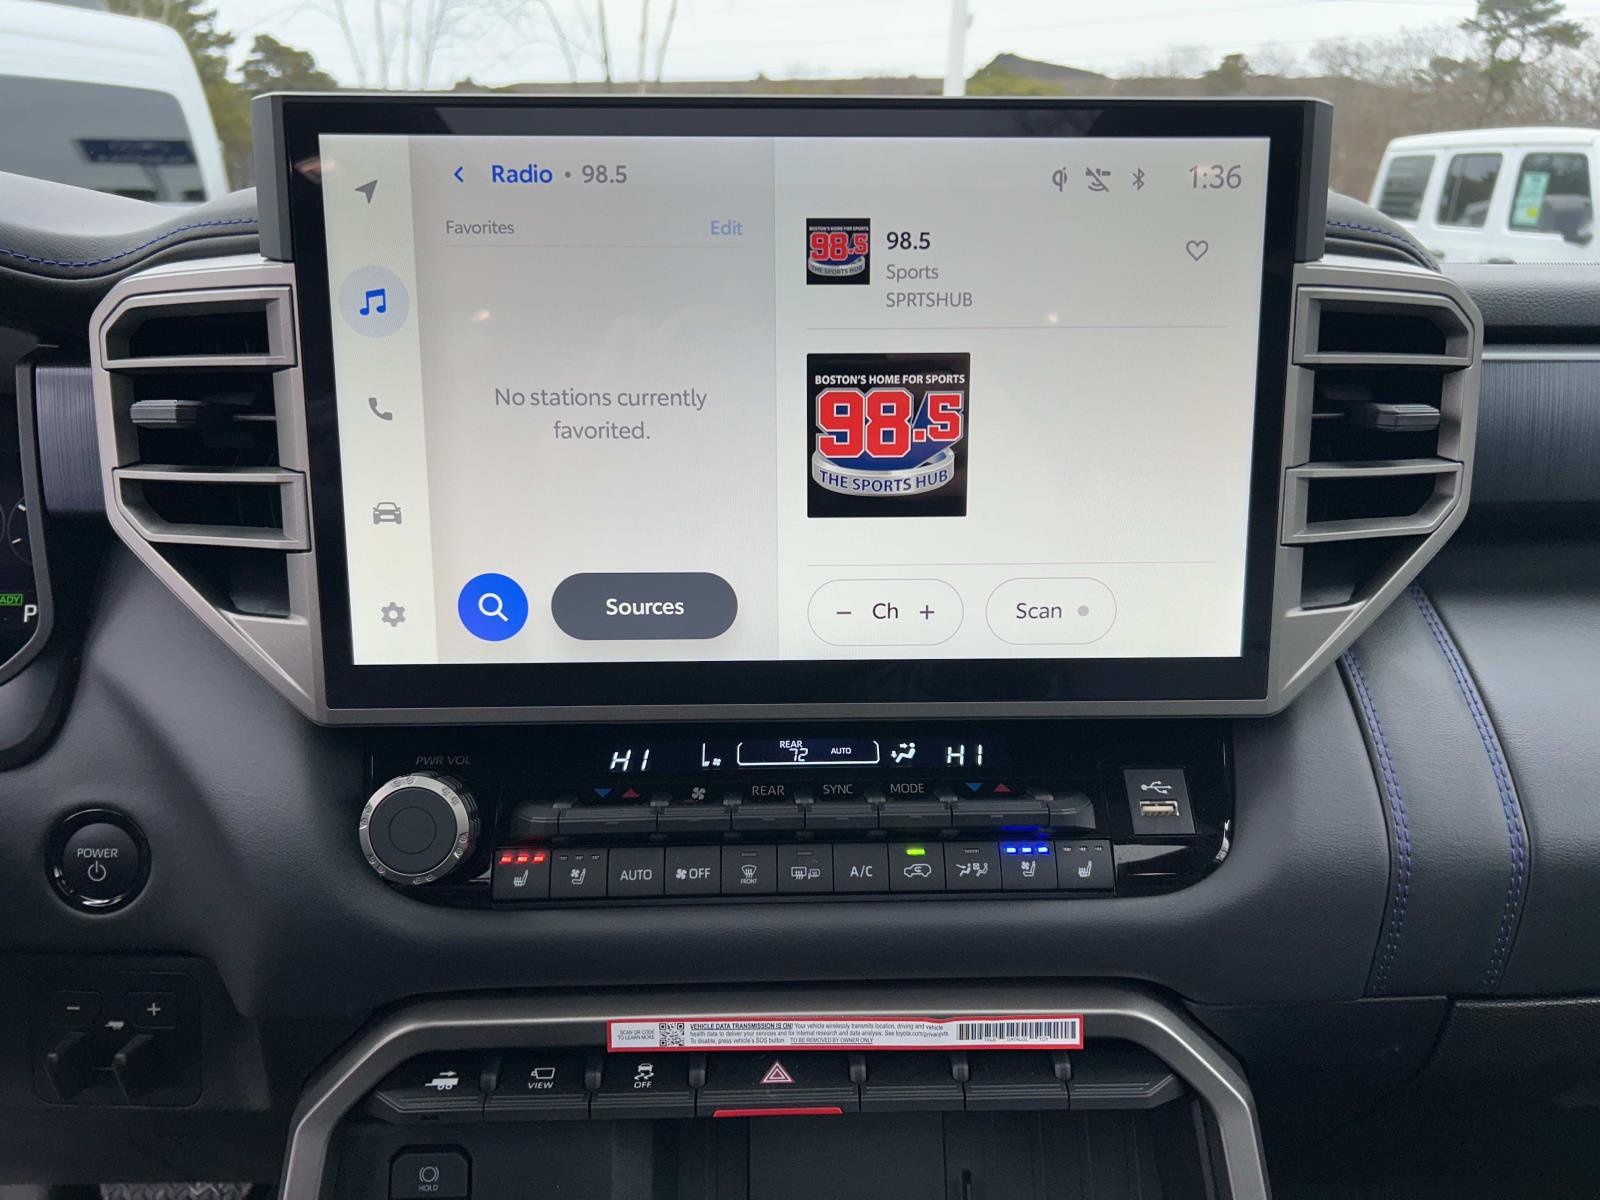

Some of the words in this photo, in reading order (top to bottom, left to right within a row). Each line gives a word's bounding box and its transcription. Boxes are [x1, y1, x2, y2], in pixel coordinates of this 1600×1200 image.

[491, 164, 553, 184] Radio
[581, 165, 628, 184] 98.5
[1188, 166, 1242, 191] 1:36
[445, 219, 515, 236] Favorites
[710, 220, 744, 236] Edit
[809, 232, 869, 261] 98.5
[886, 231, 931, 250] 98.5
[886, 264, 939, 283] Sports
[886, 292, 973, 308] SPRTSHUB
[815, 374, 867, 386] BOSTON'S
[869, 374, 901, 385] HOME
[903, 374, 924, 385] FOR
[926, 373, 966, 385] SPORTS
[494, 388, 526, 407] No
[530, 388, 613, 407] stations
[616, 388, 708, 411] currently
[553, 420, 651, 440] favorited.
[816, 388, 964, 459] 98.5
[819, 470, 848, 489] THE
[852, 478, 913, 494] SPORTS
[916, 469, 949, 489] HUB
[23, 604, 38, 623] P
[605, 598, 685, 616] Sources
[872, 602, 899, 619] Ch
[1016, 602, 1063, 620] Scan
[779, 740, 804, 749] REAR
[830, 747, 852, 755] AUTO
[415, 755, 445, 766] PWR
[447, 755, 471, 766] VOL
[789, 748, 809, 762] 72
[751, 785, 785, 797] REAR
[822, 783, 854, 795] SYNC
[890, 783, 925, 794] MODE
[77, 847, 118, 859] POWER
[620, 869, 653, 882] AUTO
[689, 867, 711, 880] OFF
[850, 865, 873, 878] A/C
[826, 1022, 850, 1030] wirelessly
[897, 1022, 914, 1030] driving
[926, 1023, 944, 1031] vehicle
[528, 1081, 554, 1090] VIEW
[633, 1081, 653, 1089] OFF
[418, 1184, 439, 1192] HOLD
